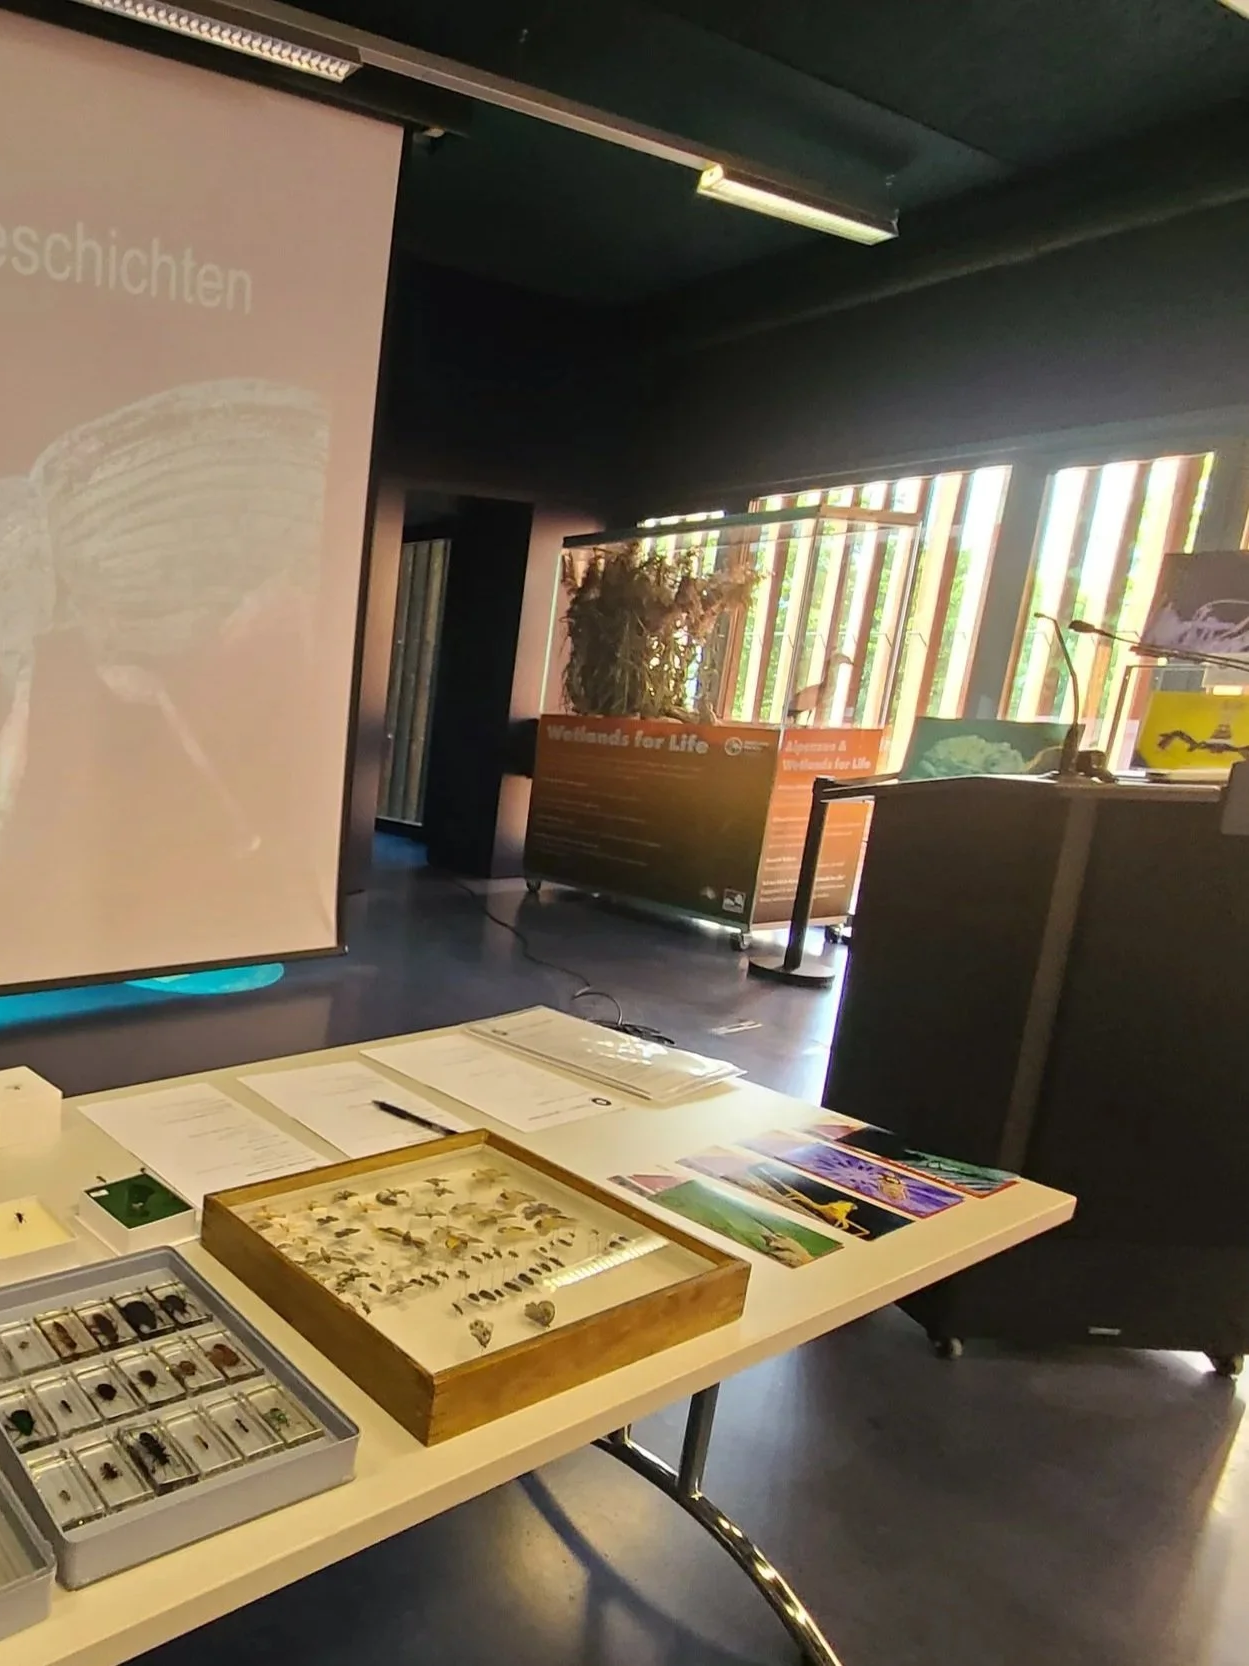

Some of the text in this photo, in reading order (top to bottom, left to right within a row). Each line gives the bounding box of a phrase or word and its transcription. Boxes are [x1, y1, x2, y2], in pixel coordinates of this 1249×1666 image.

[546, 724, 711, 754] Wetlands for Life
[833, 755, 851, 770] for
[852, 756, 872, 770] Life
